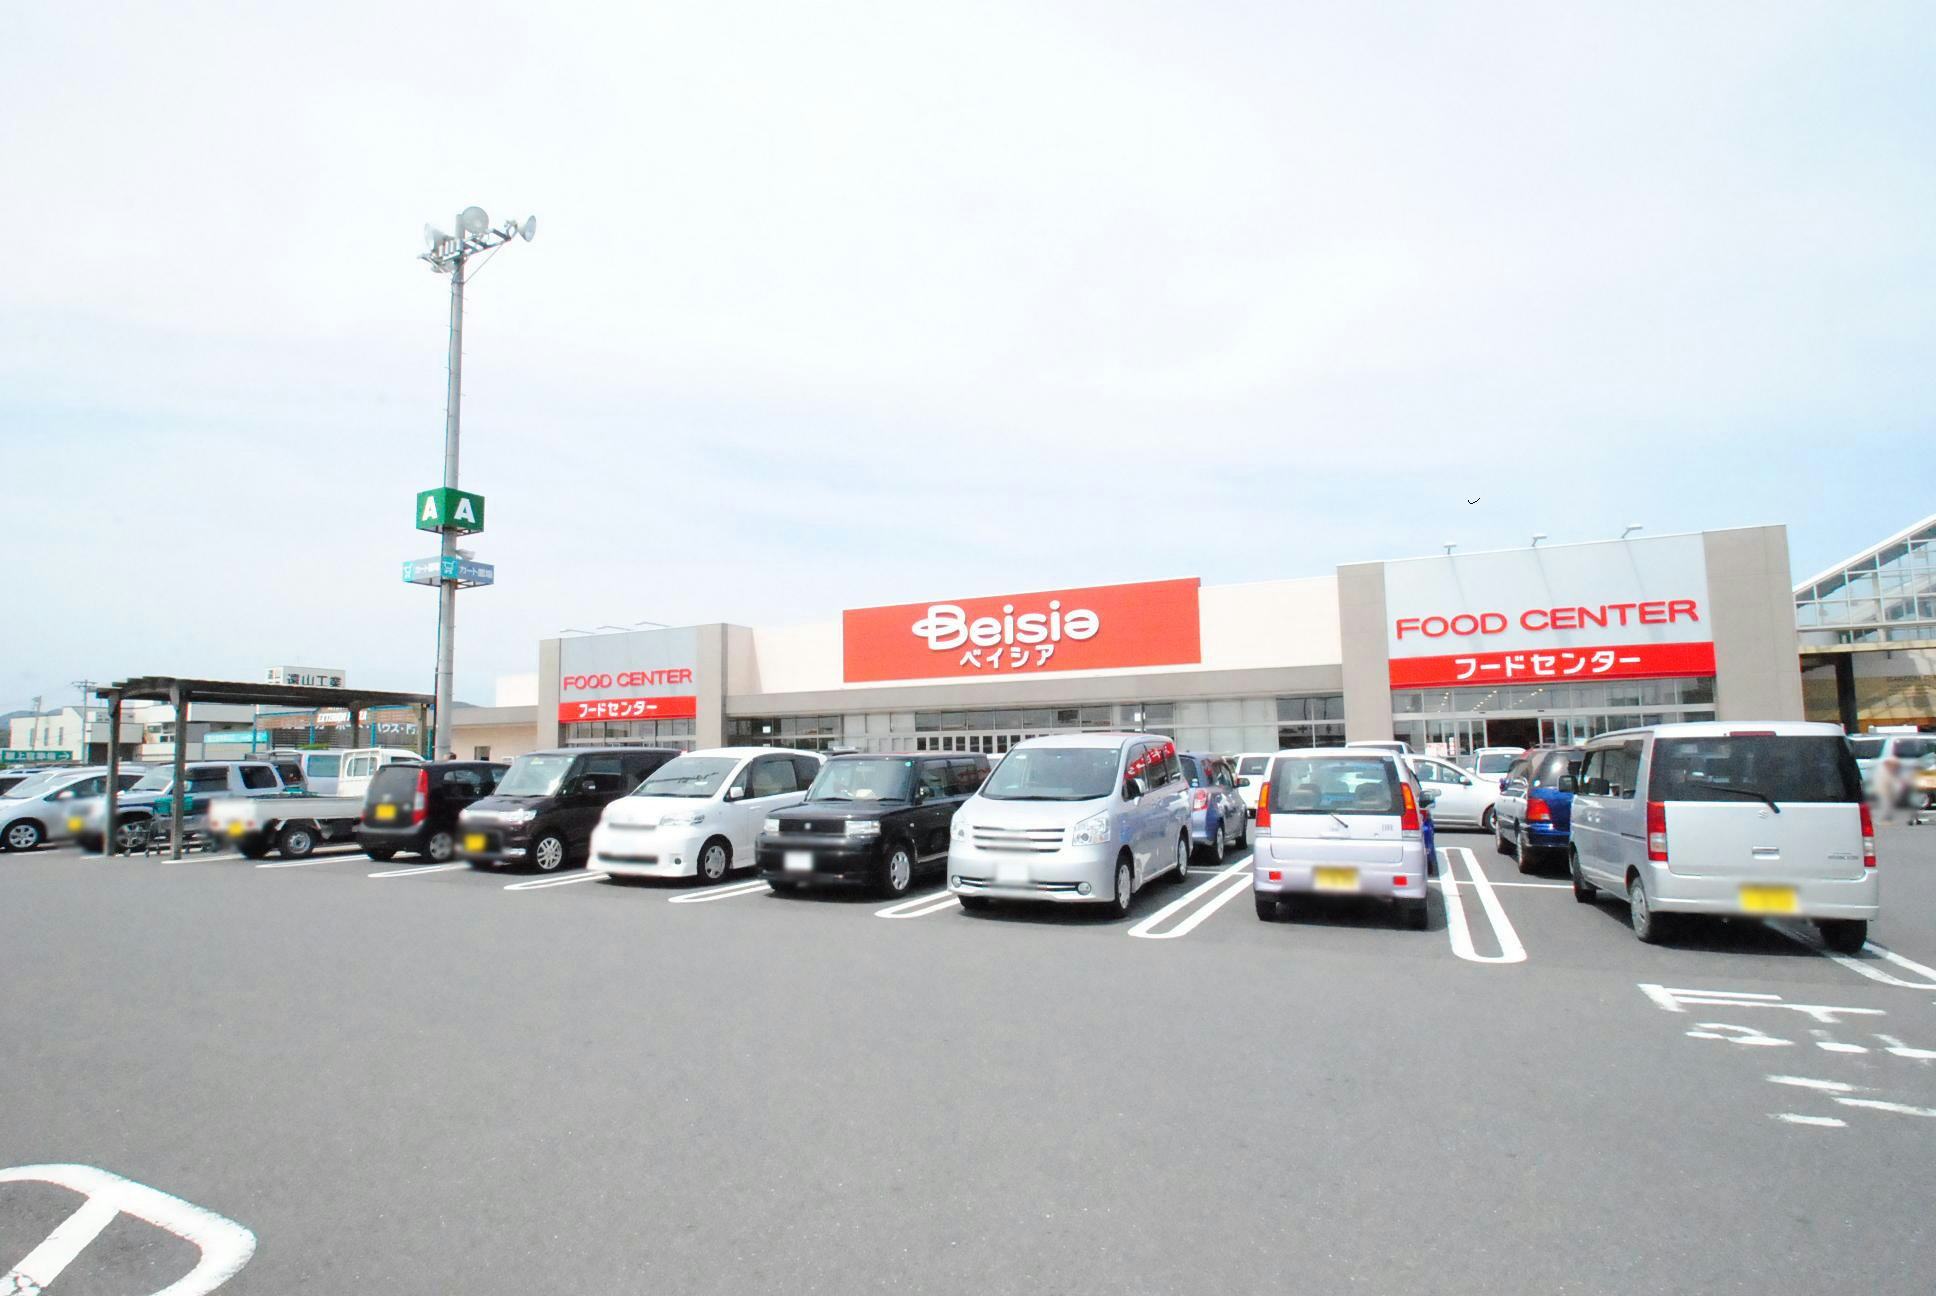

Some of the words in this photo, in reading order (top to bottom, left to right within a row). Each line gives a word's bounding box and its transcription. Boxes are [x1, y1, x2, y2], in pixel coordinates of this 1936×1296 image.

[422, 496, 438, 521] A
[454, 498, 475, 523] A
[912, 600, 1100, 651] Beisia
[1396, 612, 1508, 640] FOOD
[1520, 599, 1699, 631] CENTER
[960, 644, 1055, 668] ベイシア
[1455, 650, 1641, 680] フードセンター
[563, 673, 612, 690] FOOD
[617, 668, 692, 687] CENTER
[579, 700, 658, 717] フードセンター
